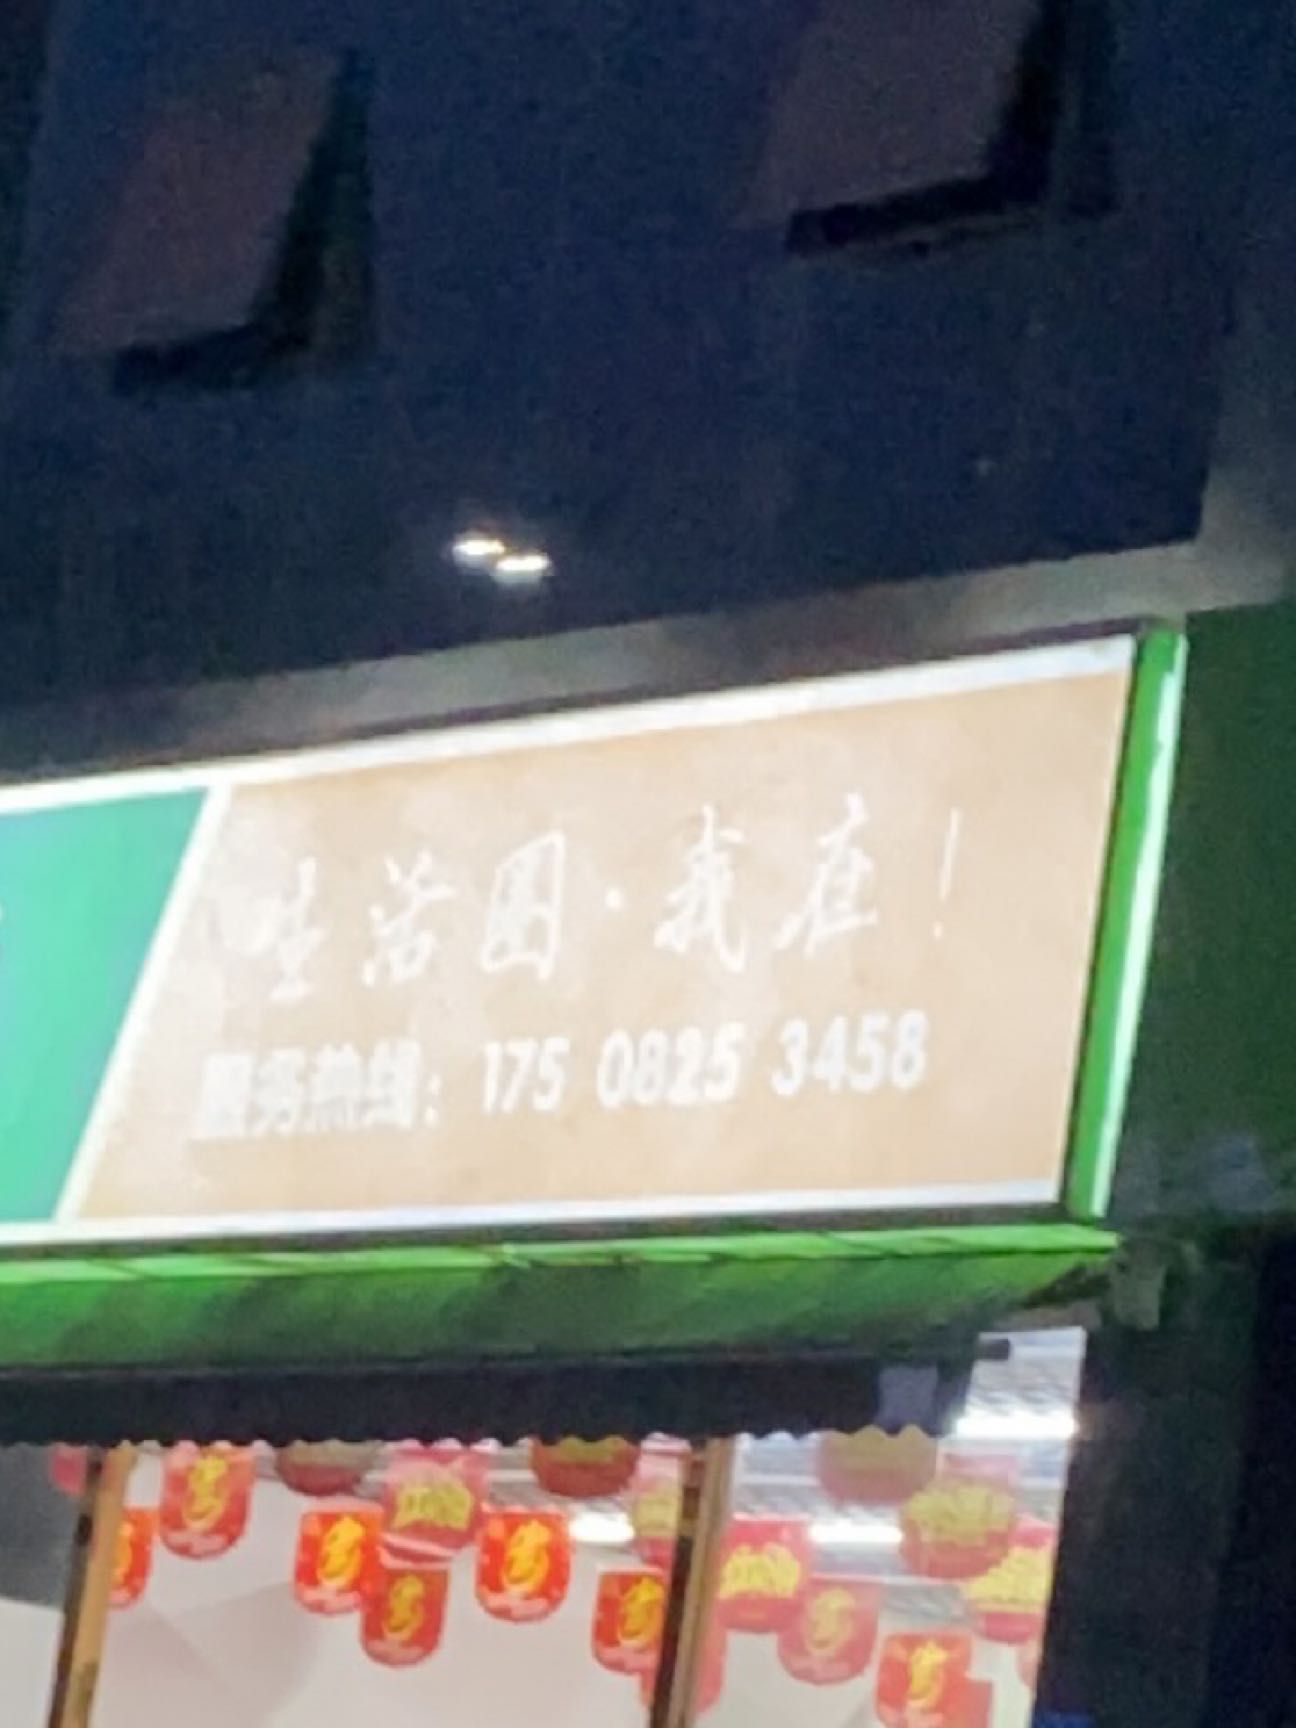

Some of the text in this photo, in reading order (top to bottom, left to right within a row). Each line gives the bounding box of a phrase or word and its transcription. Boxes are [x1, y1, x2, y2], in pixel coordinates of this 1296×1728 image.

[481, 1035, 571, 1114] 175
[597, 1020, 745, 1108] 0825
[771, 1008, 929, 1096] 3458
